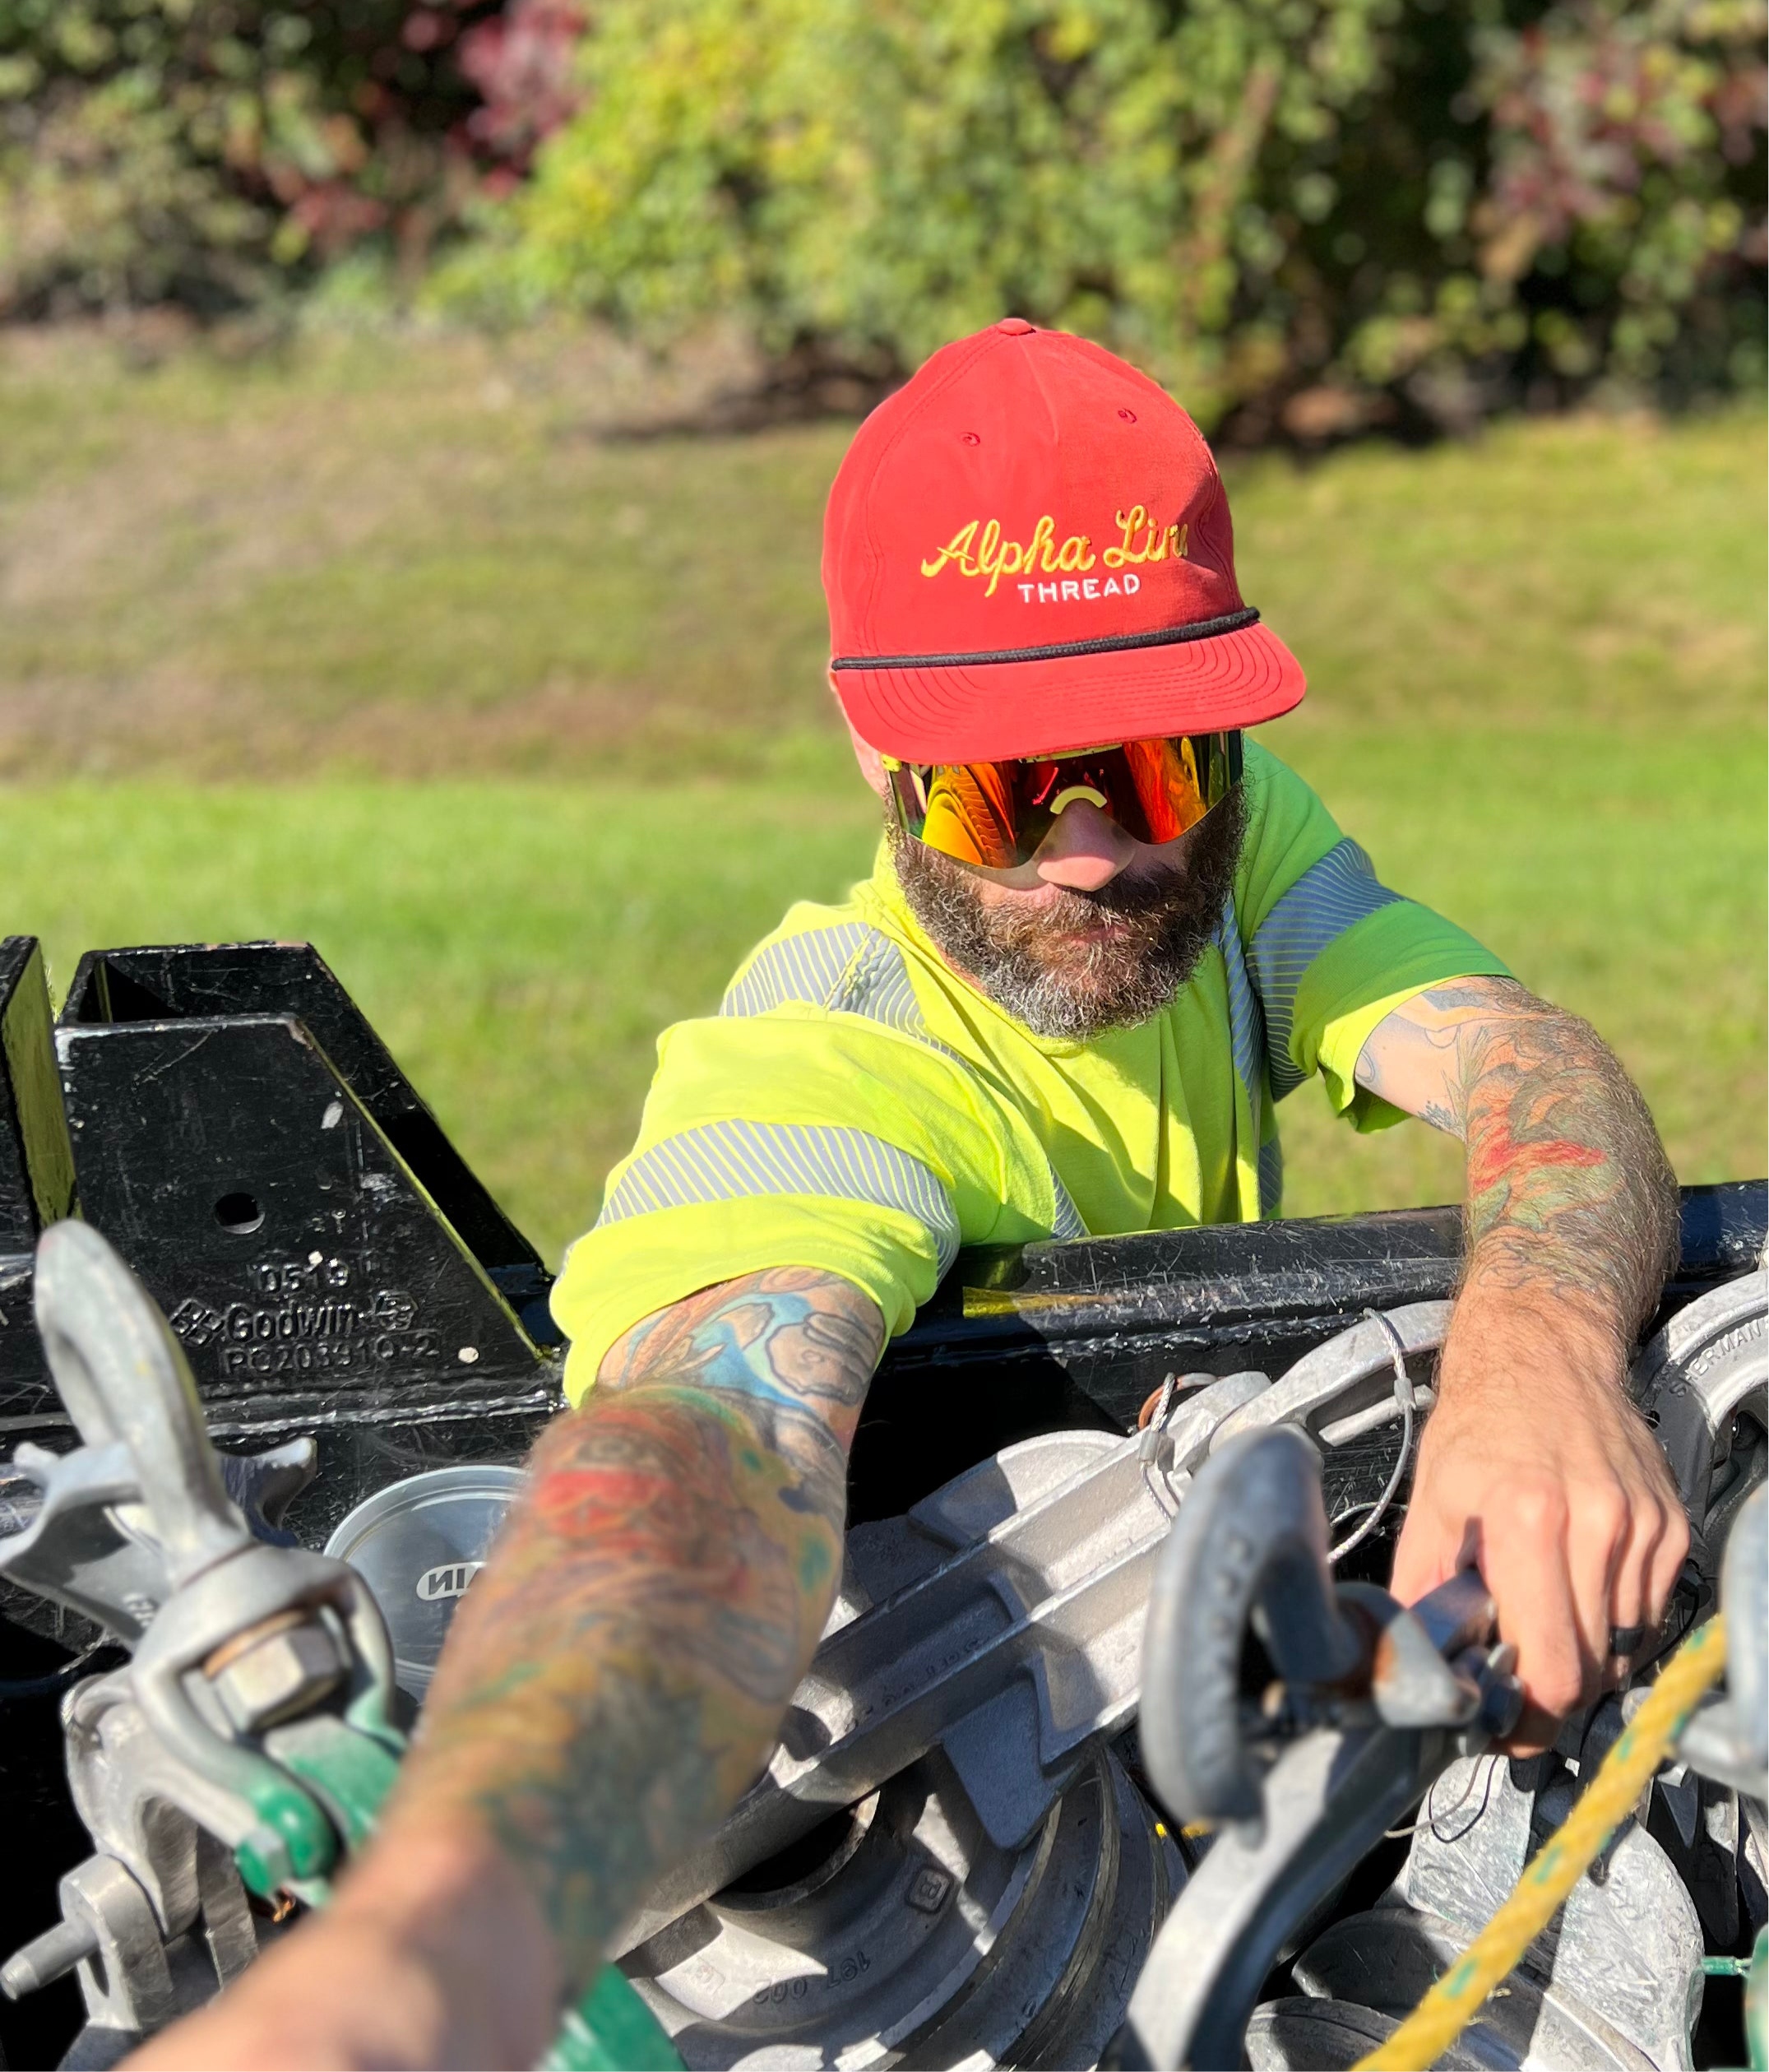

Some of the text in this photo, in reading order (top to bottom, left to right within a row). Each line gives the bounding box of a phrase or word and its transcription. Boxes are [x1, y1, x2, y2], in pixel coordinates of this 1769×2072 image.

[920, 515, 1096, 597] Alpha
[1017, 573, 1142, 604] THREAD
[225, 1298, 355, 1342] Godwin
